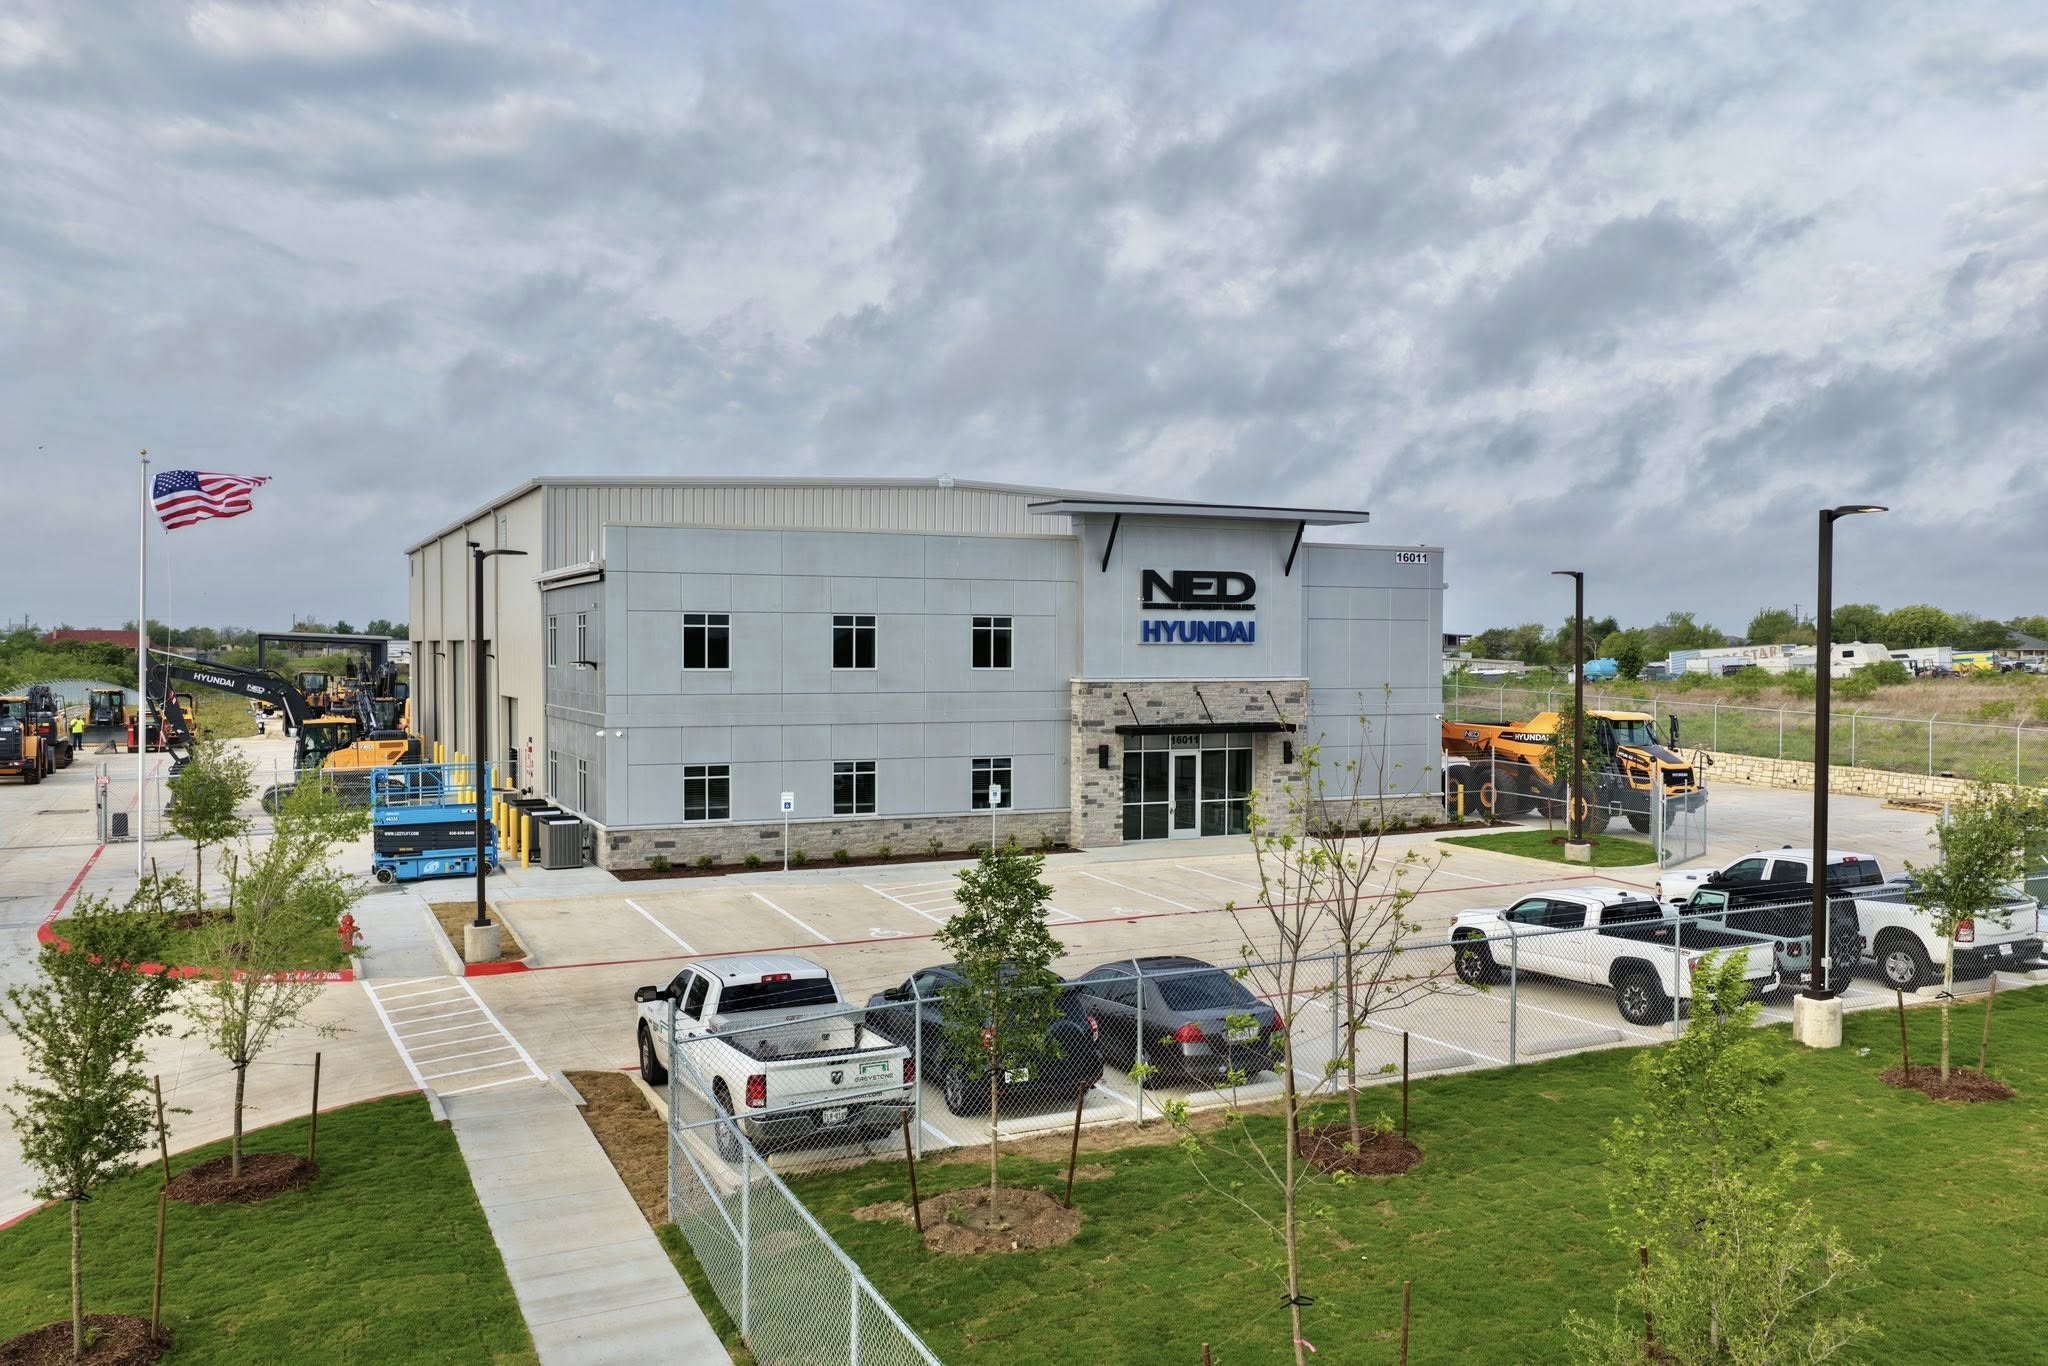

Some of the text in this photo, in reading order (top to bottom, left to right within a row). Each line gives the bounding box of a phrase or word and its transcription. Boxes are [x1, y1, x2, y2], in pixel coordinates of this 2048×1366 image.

[1397, 552, 1427, 563] 16011
[1142, 569, 1256, 602] NED
[1143, 620, 1256, 643] HYUNDAI
[193, 672, 235, 688] HYUNDAI
[1171, 735, 1199, 744] 16011
